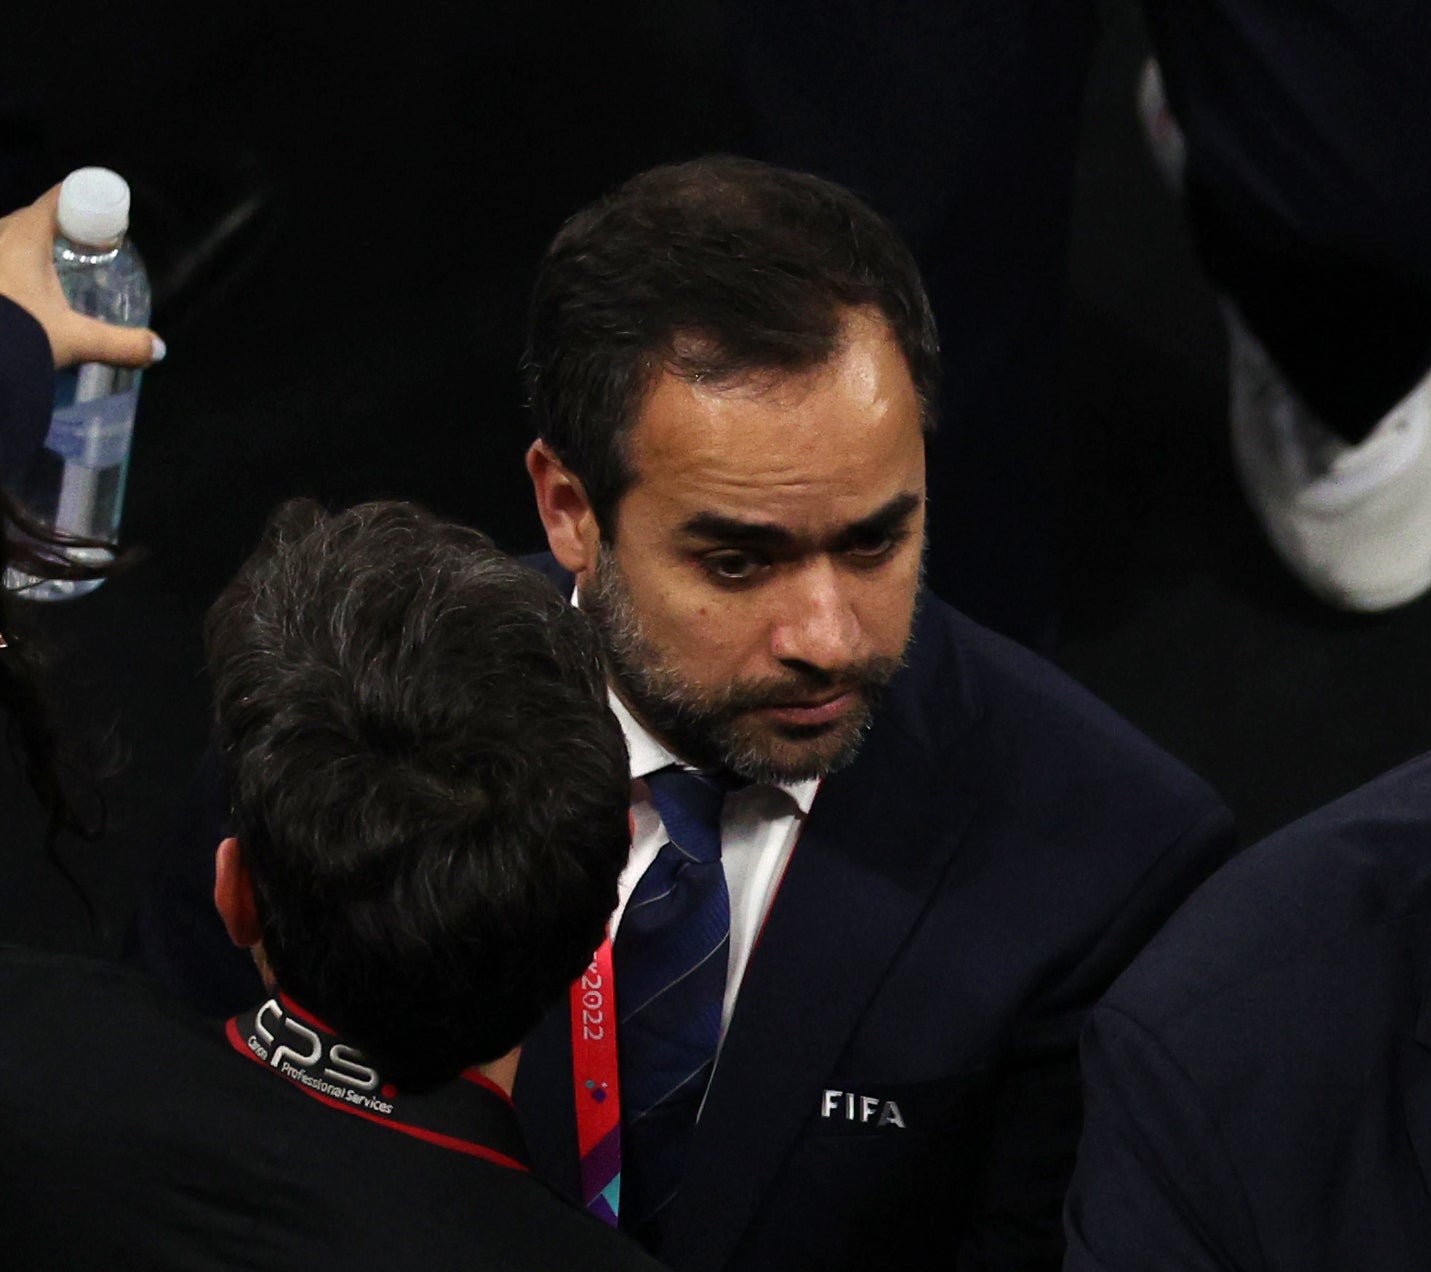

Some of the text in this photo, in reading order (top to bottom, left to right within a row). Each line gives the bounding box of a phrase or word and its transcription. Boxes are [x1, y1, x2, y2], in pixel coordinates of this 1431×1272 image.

[248, 1035, 395, 1115] Canon Professional Services
[821, 1089, 906, 1129] FIFA
